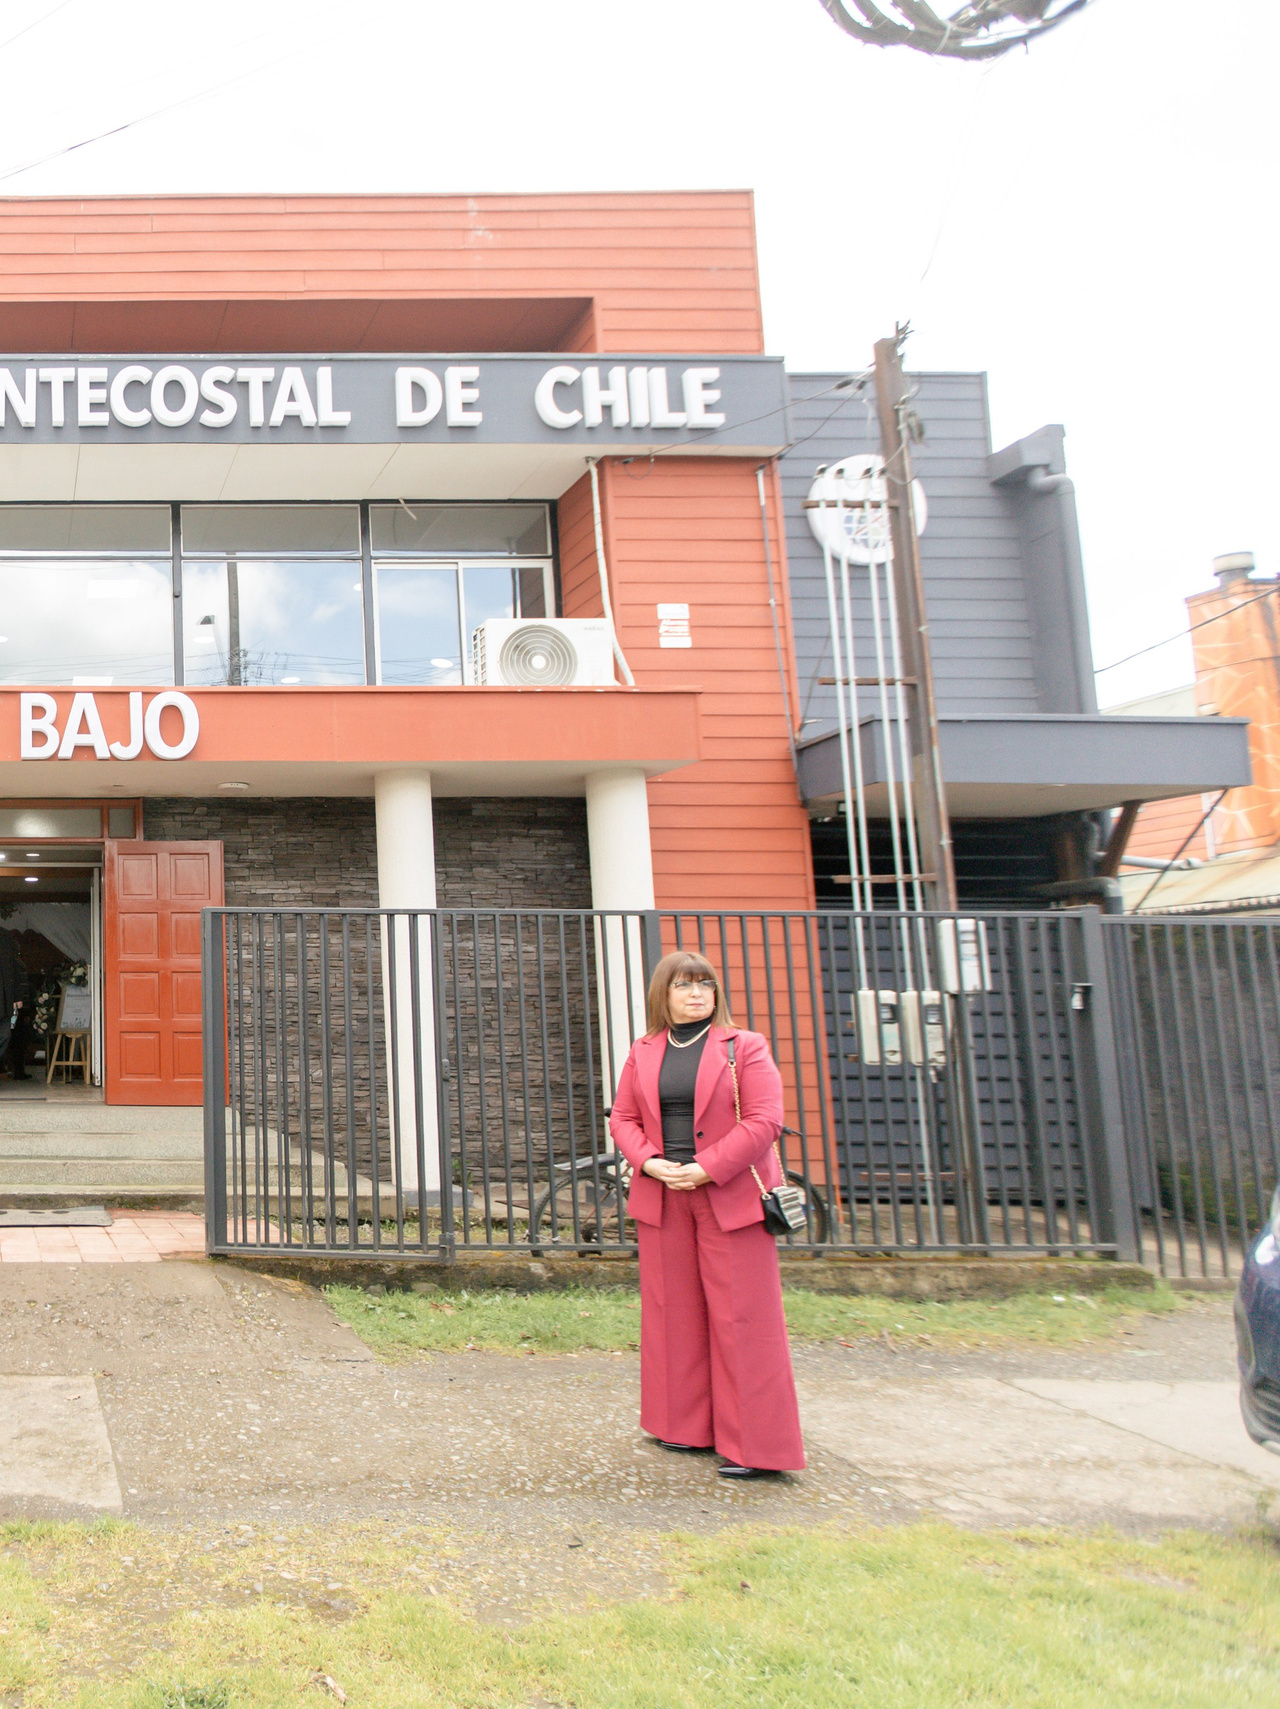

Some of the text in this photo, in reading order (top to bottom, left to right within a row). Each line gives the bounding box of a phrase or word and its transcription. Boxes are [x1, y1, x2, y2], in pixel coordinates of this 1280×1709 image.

[395, 366, 483, 428] DE
[534, 366, 726, 431] CHILE
[21, 691, 200, 761] BAJO
